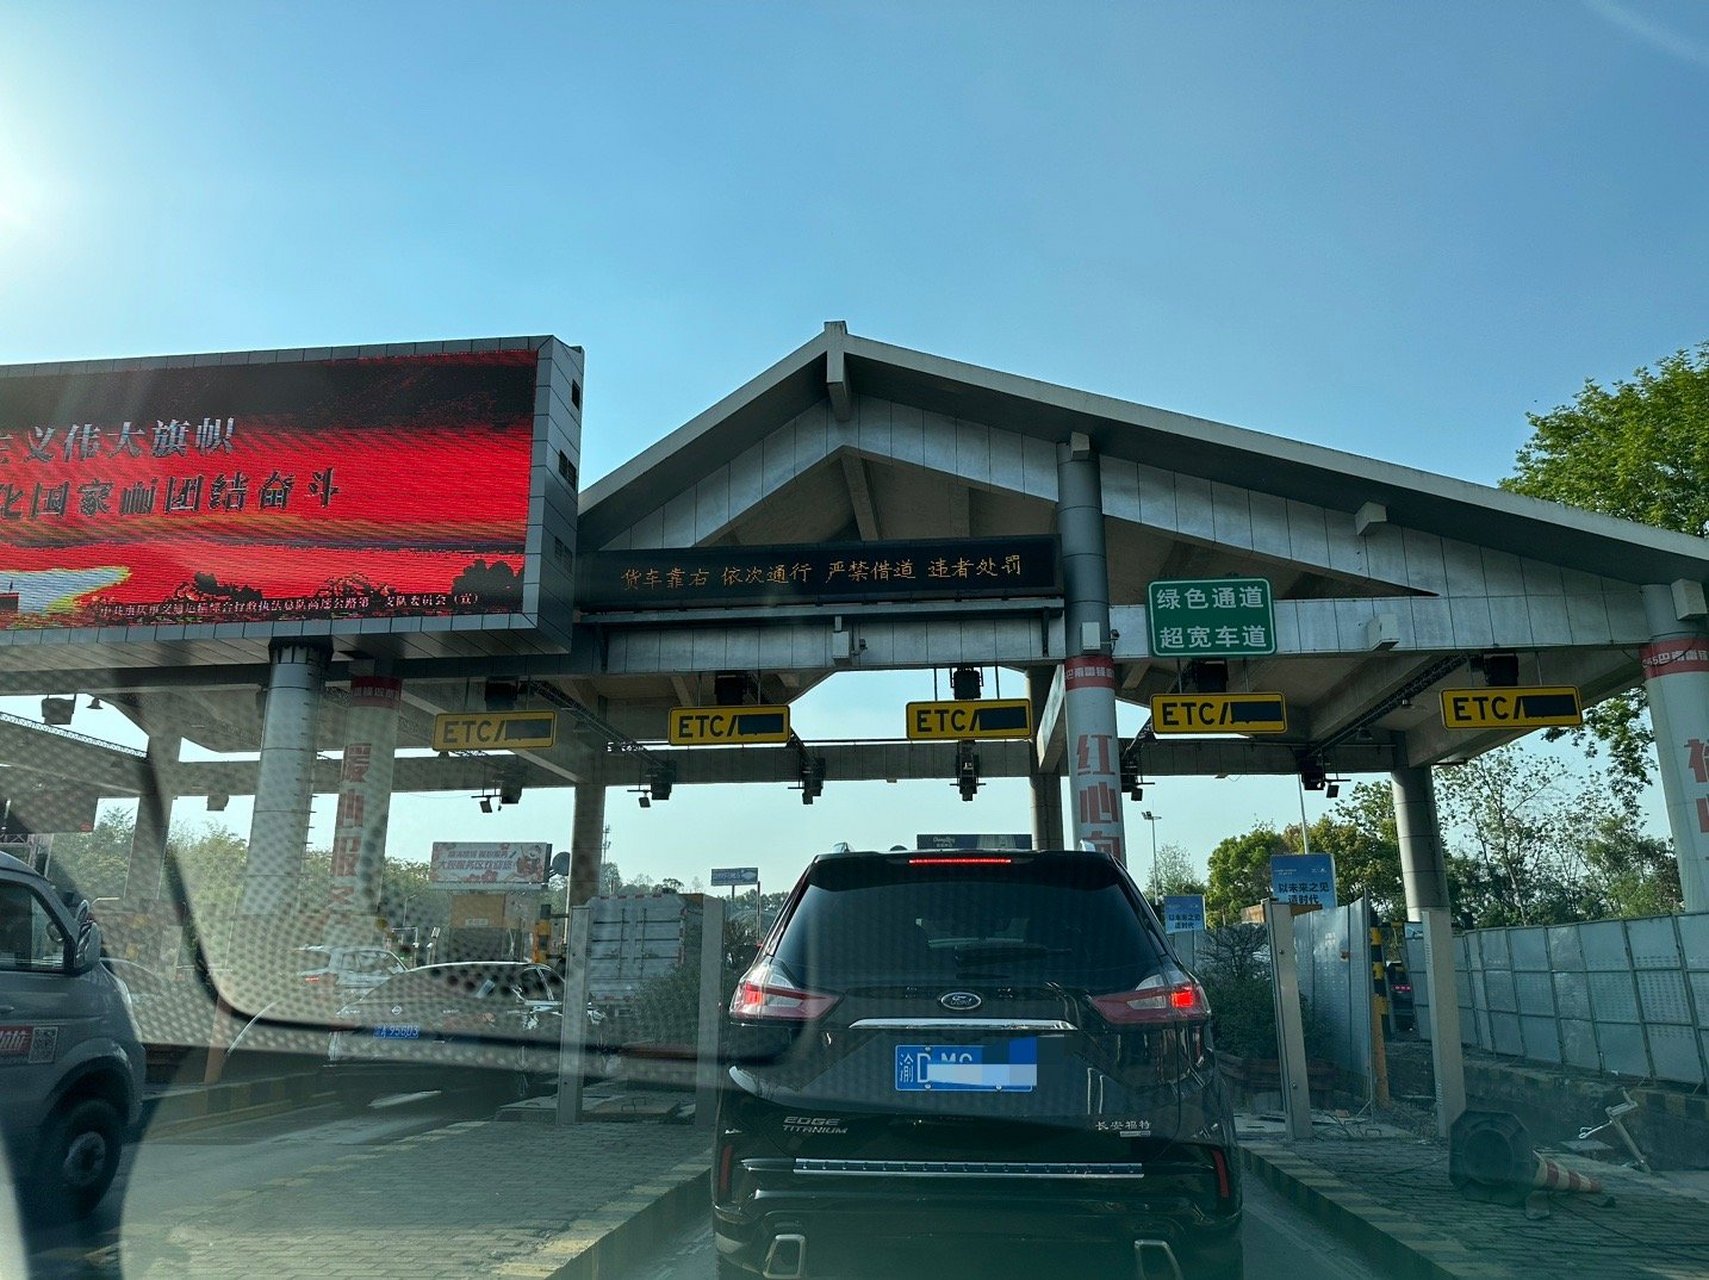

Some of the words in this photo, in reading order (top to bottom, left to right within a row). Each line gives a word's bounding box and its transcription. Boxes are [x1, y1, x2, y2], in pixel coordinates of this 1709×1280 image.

[621, 567, 710, 591] 货车靠右
[721, 562, 813, 587] 依次通行
[826, 559, 916, 584] 严禁借道
[928, 554, 1021, 578] 违者处罚
[1156, 586, 1264, 609] 绿色通道
[1160, 625, 1267, 648] 超宽车道
[1278, 882, 1330, 893] 以未来之见
[783, 1116, 840, 1126] EDGE
[1095, 1120, 1151, 1131] 长安福特
[782, 1124, 848, 1134] TITANIUM
